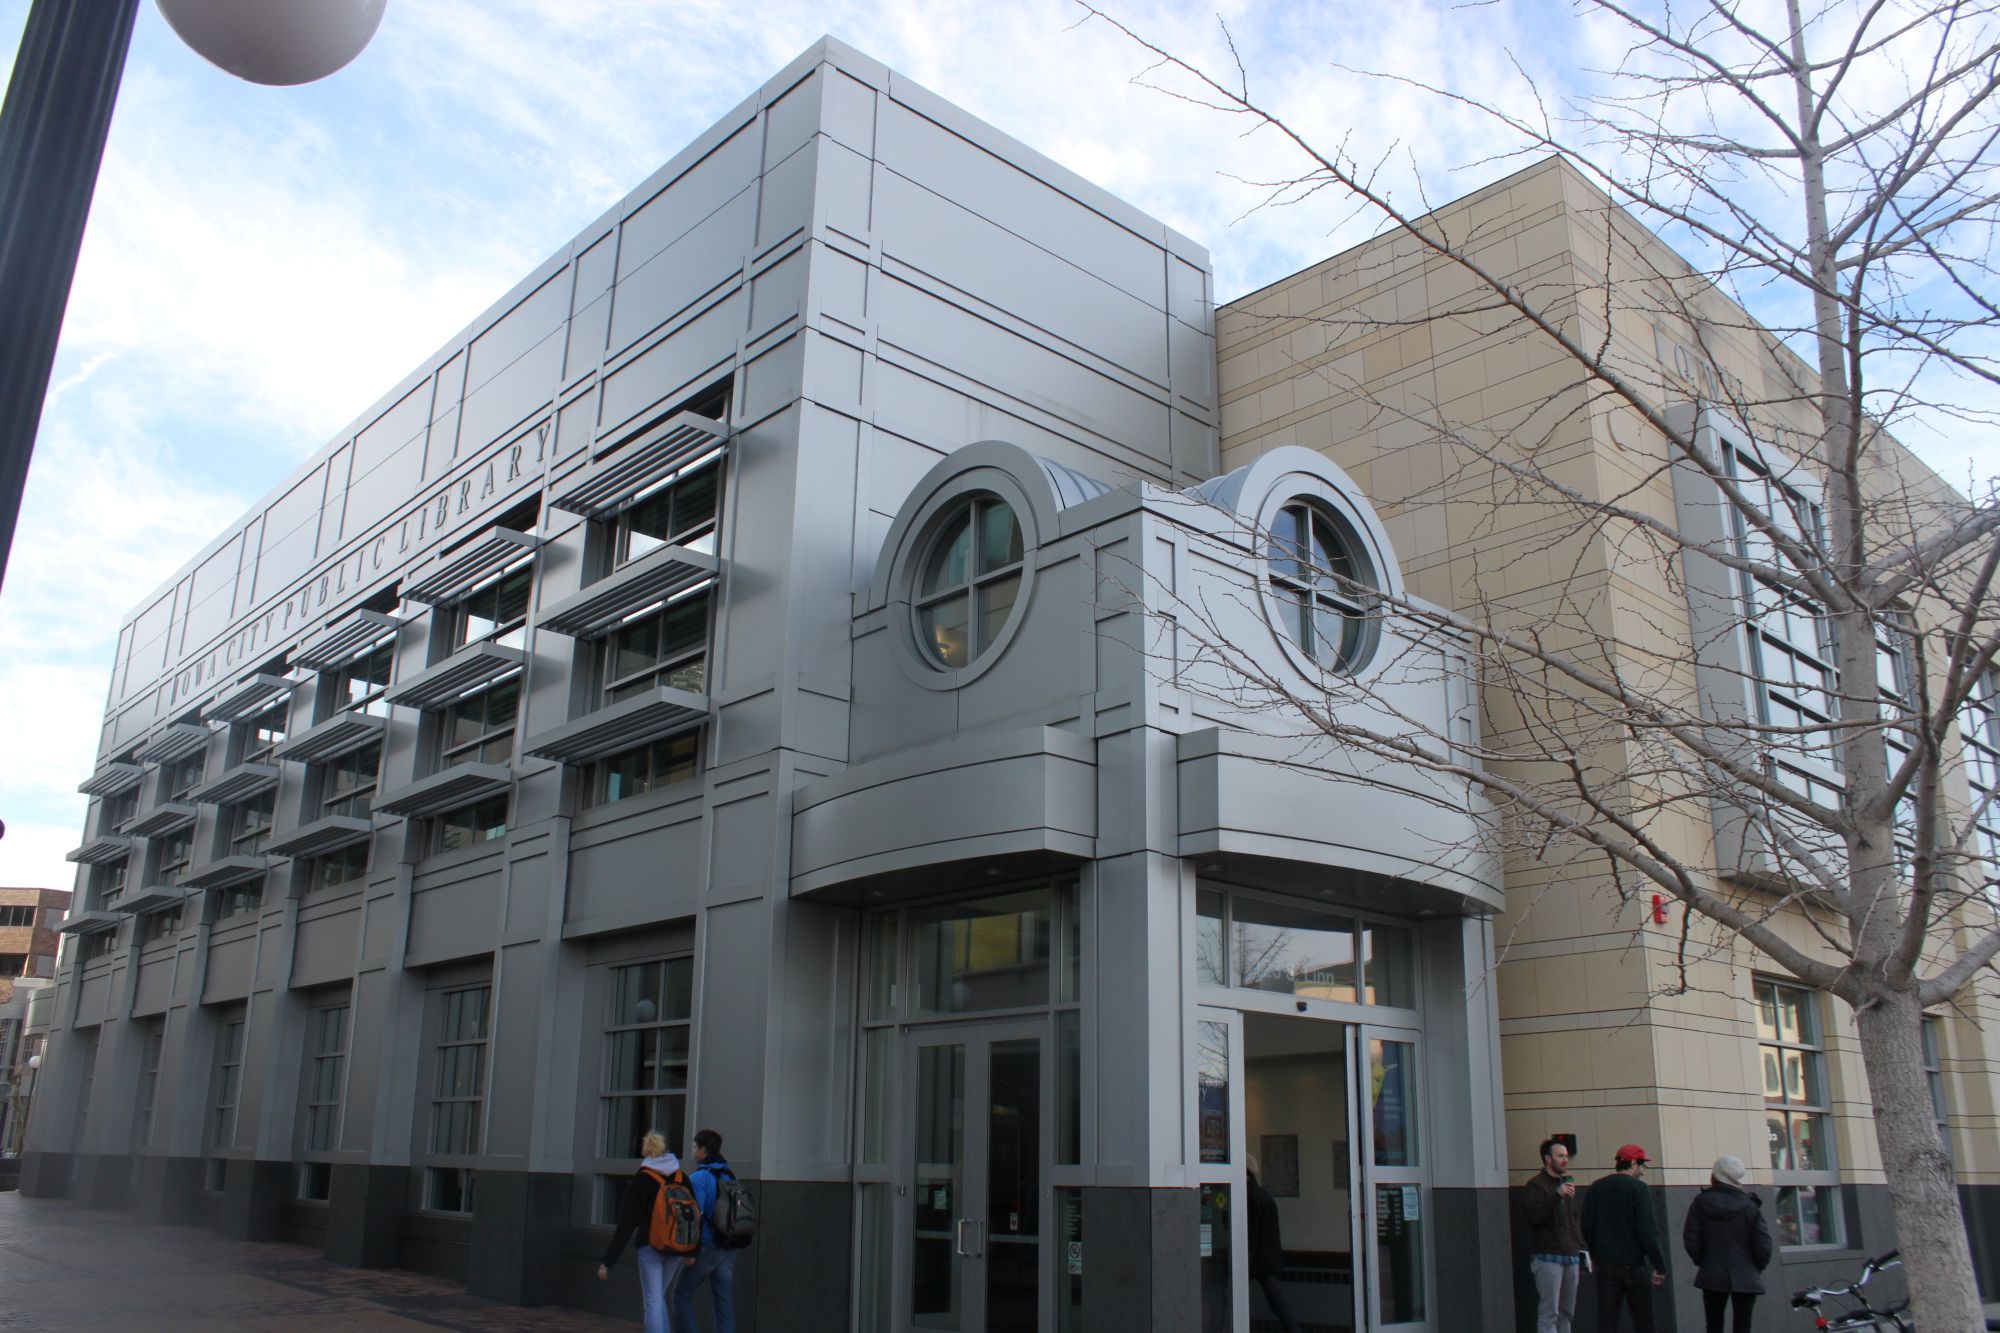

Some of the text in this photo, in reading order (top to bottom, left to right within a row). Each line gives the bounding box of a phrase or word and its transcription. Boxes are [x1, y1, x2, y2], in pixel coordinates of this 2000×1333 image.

[172, 423, 551, 705] IOWA CITY PUBLIC LIBRARY
[1304, 966, 1335, 985] Linn
